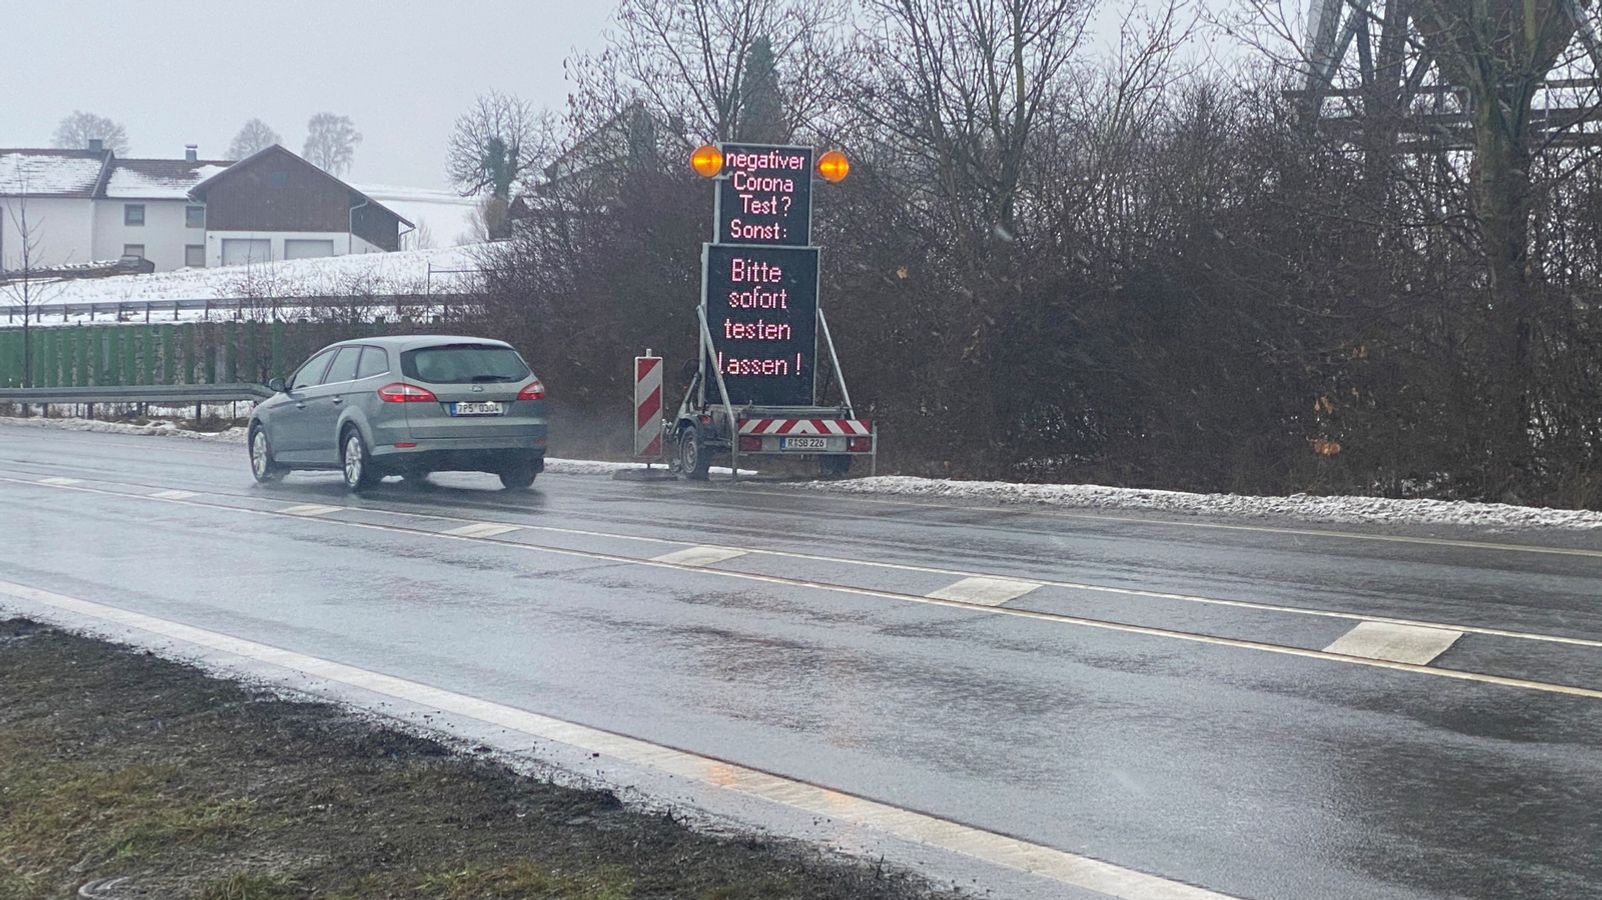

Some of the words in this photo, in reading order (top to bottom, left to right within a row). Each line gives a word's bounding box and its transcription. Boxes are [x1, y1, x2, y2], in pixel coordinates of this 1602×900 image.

[726, 150, 804, 171] negativer
[734, 171, 793, 192] Corona
[731, 258, 782, 282] Bitte
[729, 286, 787, 309] sofort
[724, 318, 791, 340] testen
[717, 351, 787, 375] lassen
